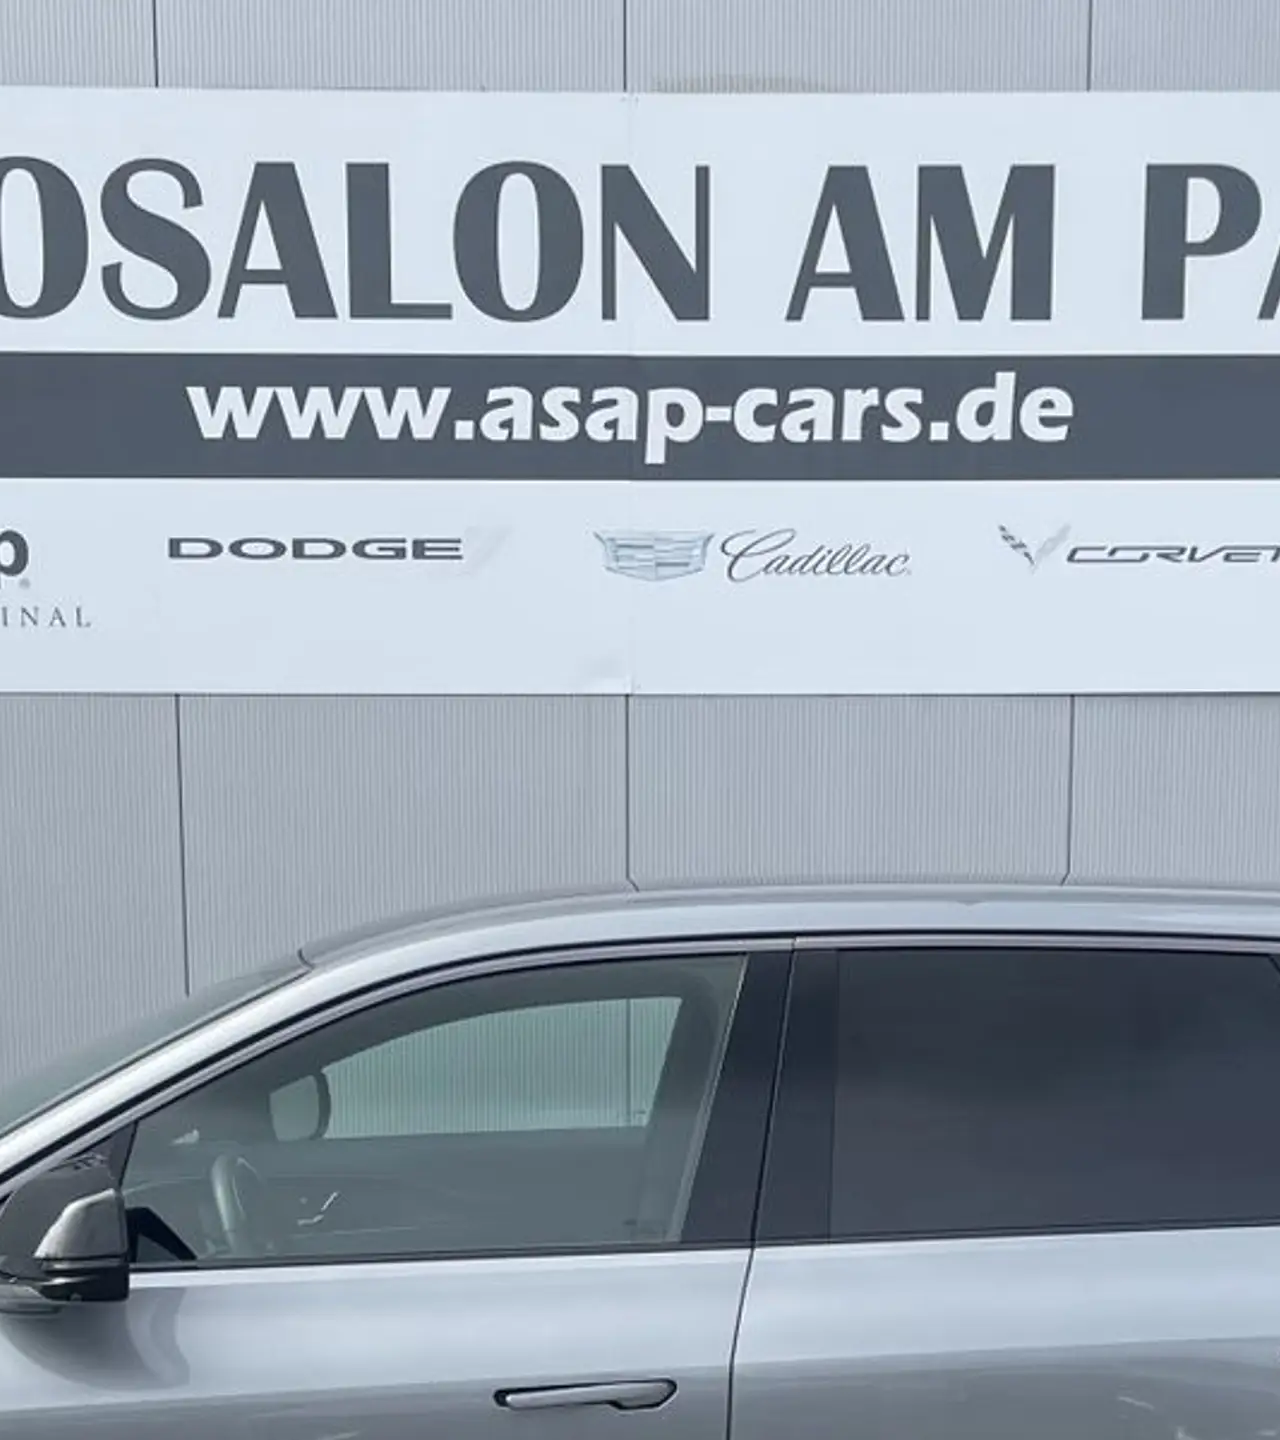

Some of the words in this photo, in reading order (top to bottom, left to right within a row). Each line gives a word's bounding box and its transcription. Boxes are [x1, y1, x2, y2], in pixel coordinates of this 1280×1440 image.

[784, 163, 1056, 323] AM
[185, 370, 1075, 466] www.asap-cars.de
[167, 536, 464, 562] DODGE
[718, 528, 910, 583] Cadillac
